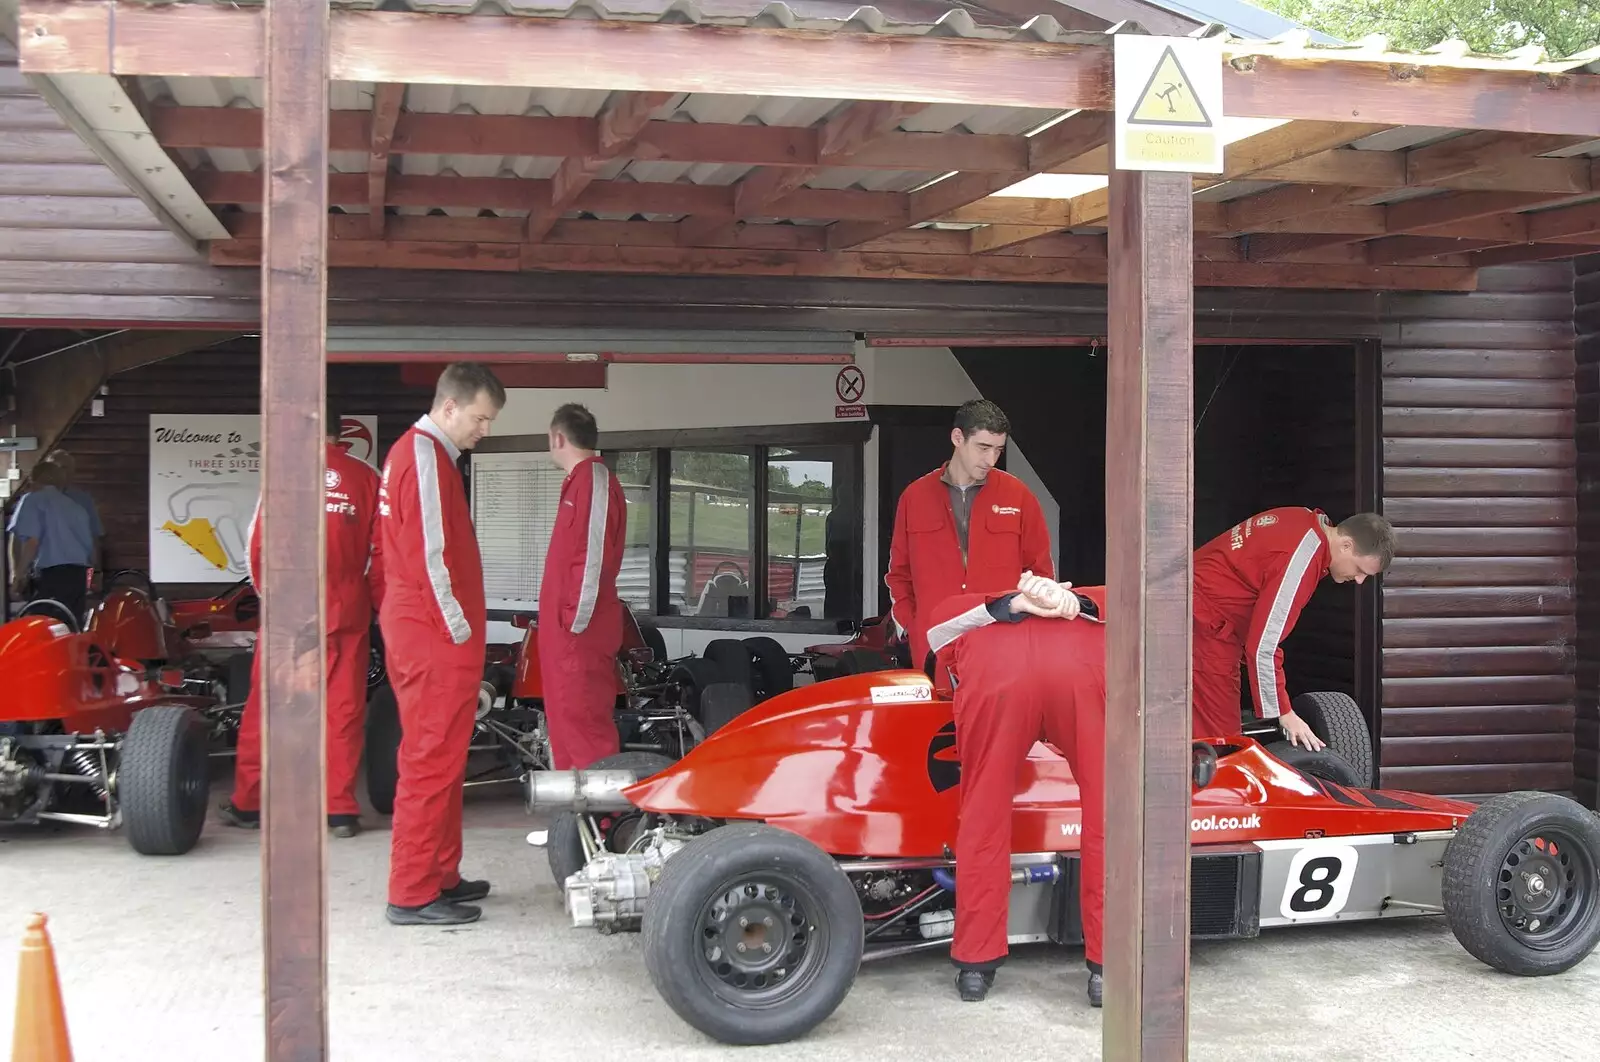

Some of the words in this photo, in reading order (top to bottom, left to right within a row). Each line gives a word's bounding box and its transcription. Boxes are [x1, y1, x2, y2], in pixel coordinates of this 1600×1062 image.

[1145, 132, 1195, 146] Caution
[154, 427, 222, 443] Welcome
[227, 430, 243, 443] to
[188, 459, 224, 468] THREE
[1290, 856, 1342, 913] 8
